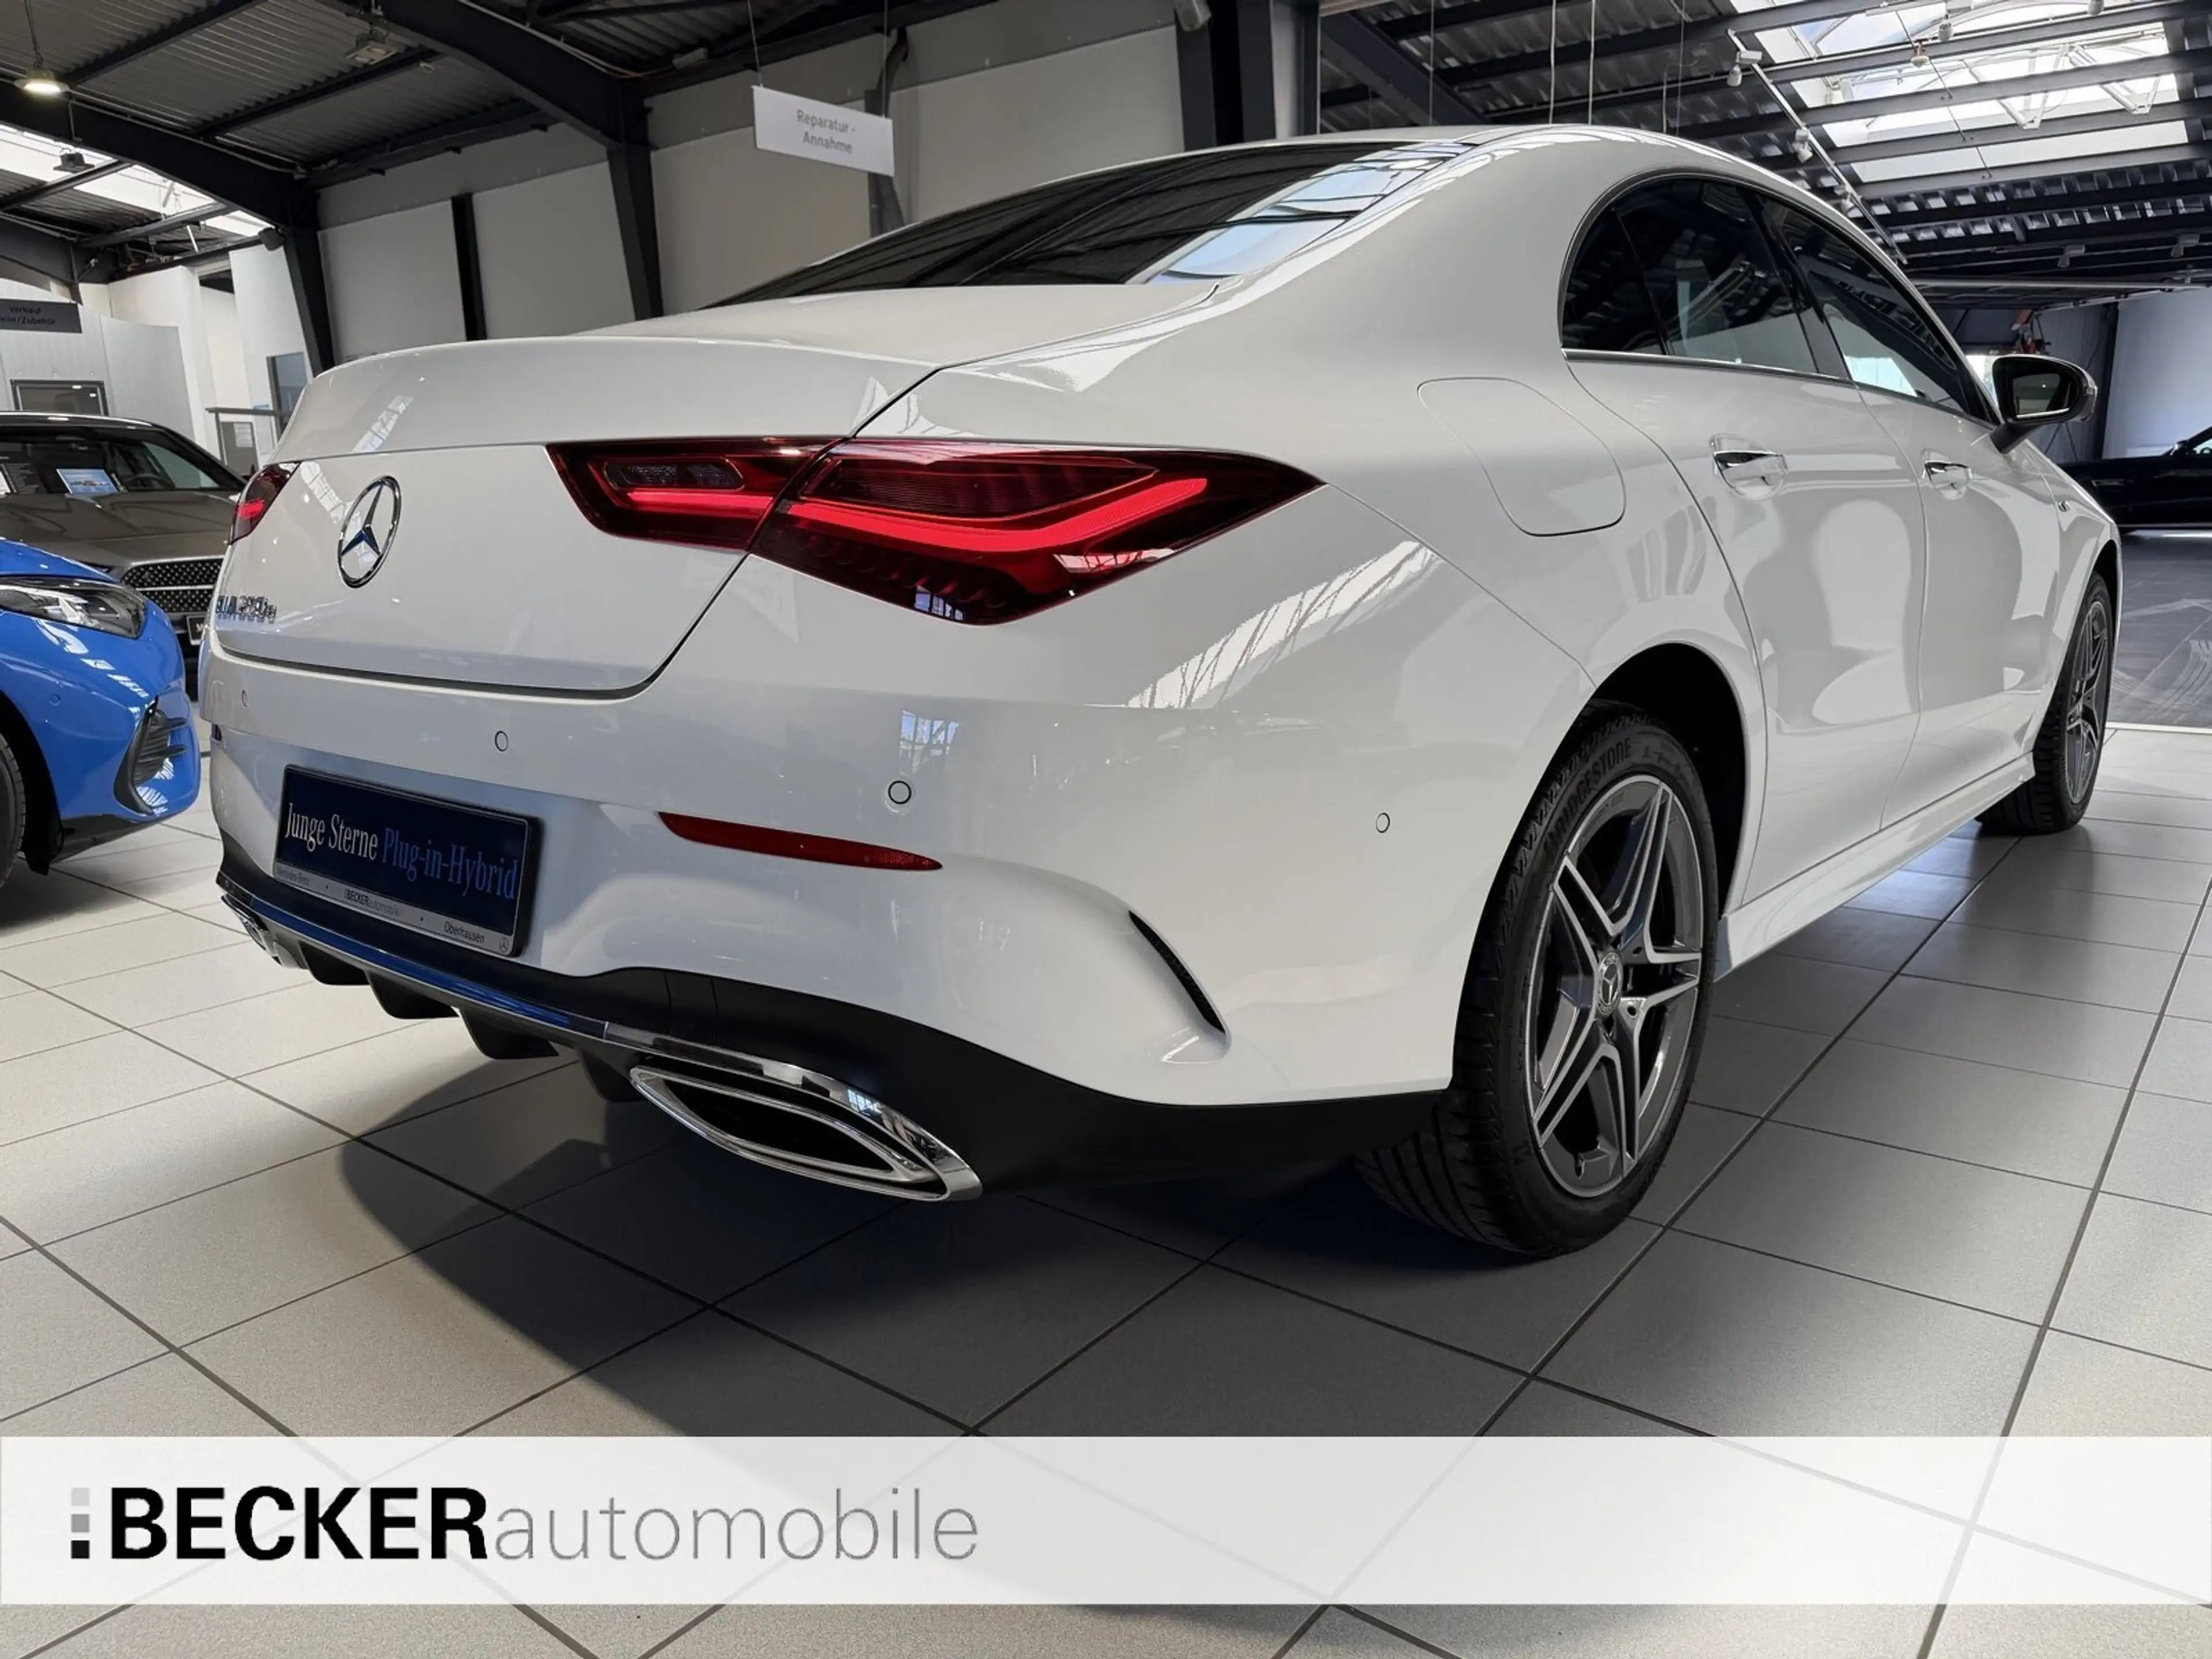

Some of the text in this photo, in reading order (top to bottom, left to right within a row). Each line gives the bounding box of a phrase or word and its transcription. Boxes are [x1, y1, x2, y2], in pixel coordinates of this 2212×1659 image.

[803, 131, 853, 154] Annahme
[285, 802, 518, 900] Junge Sterne Plug-in-Hybrid
[444, 921, 485, 944] Oberhausen
